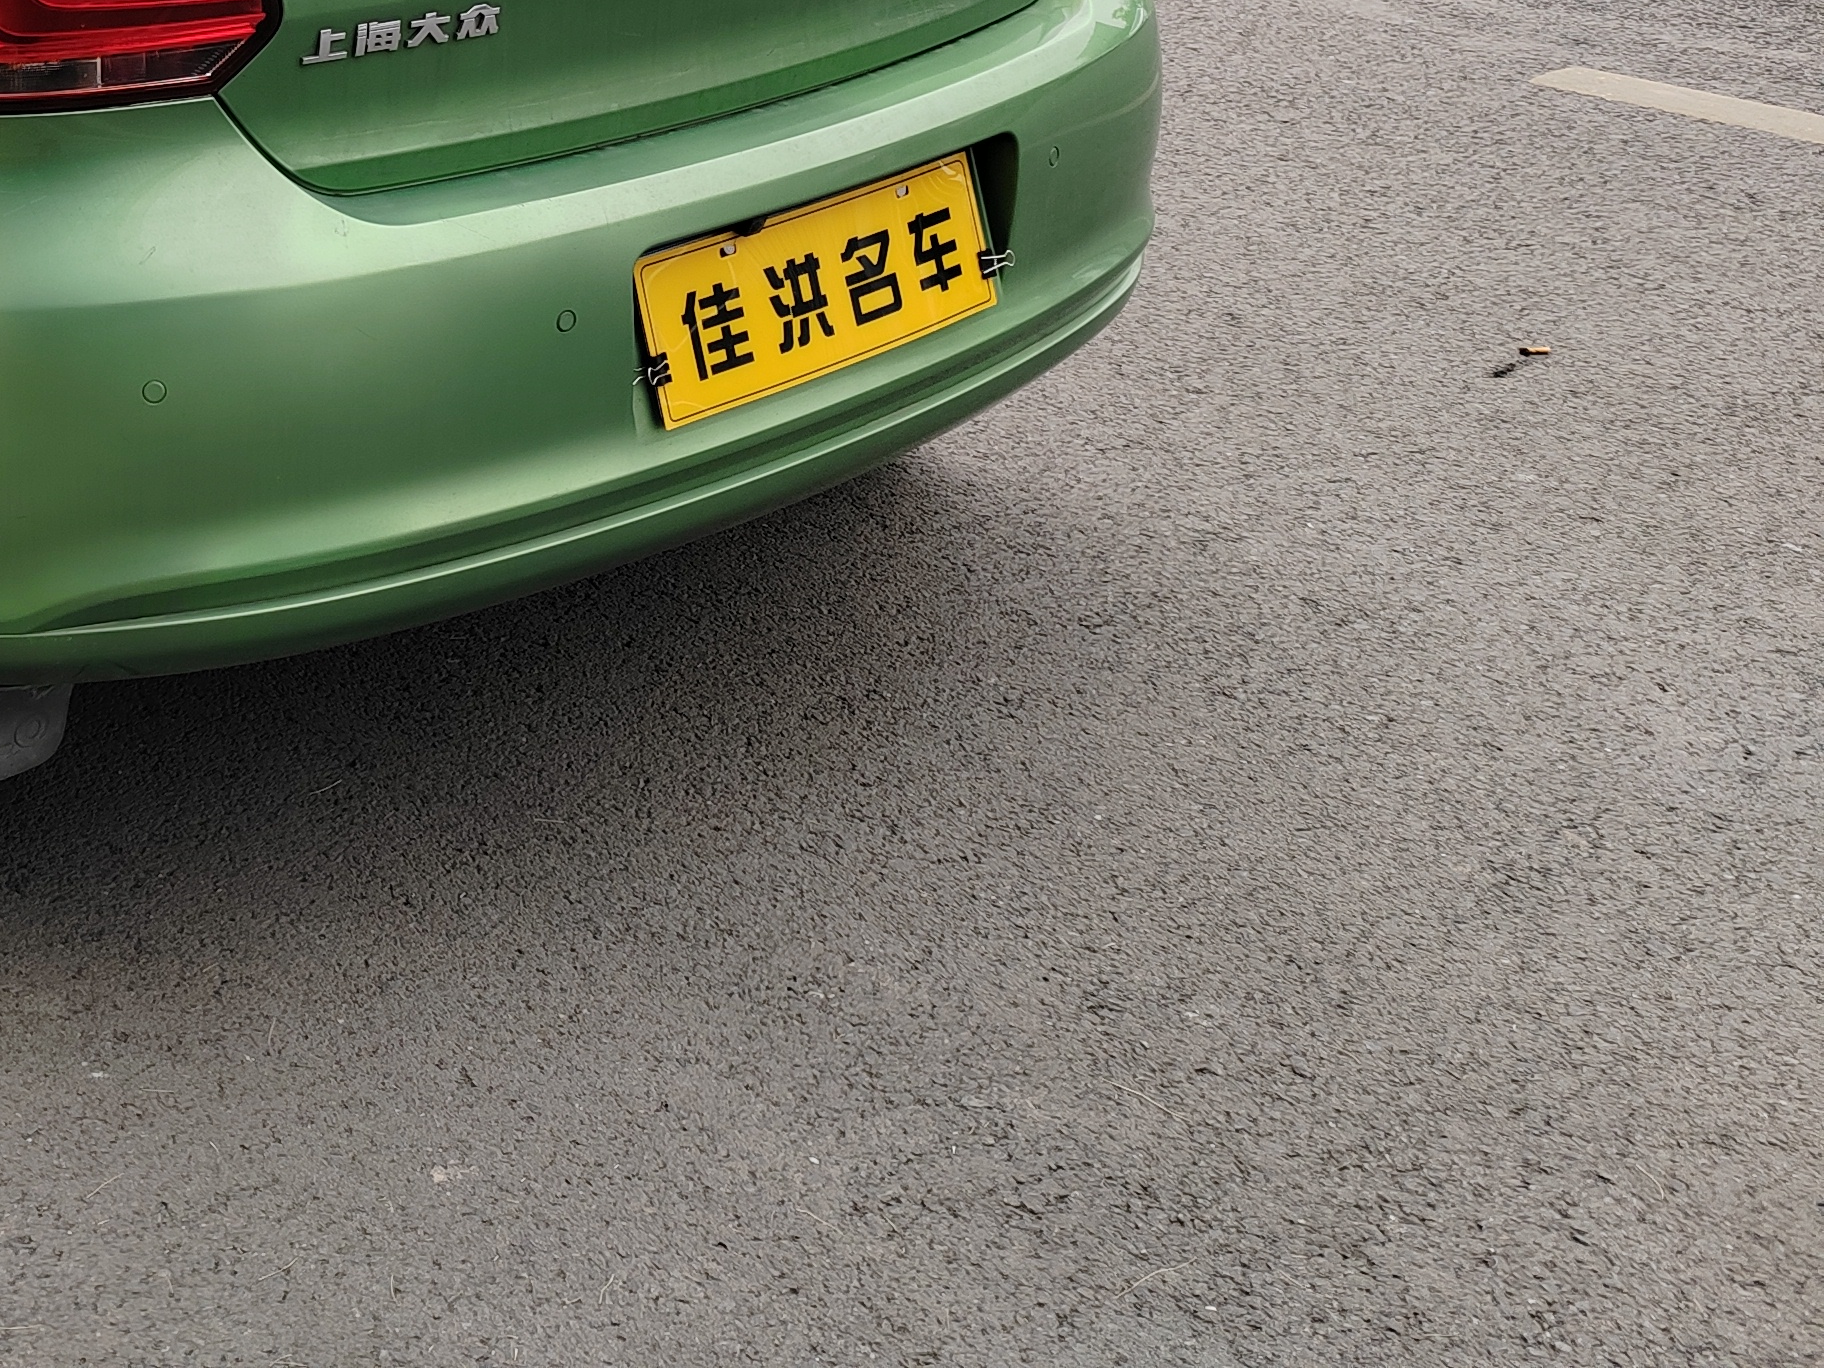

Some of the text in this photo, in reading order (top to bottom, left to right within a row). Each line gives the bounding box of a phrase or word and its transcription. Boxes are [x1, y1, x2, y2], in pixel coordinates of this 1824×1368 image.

[301, 3, 501, 65] 上海大众
[681, 206, 964, 382] 佳洪名车
